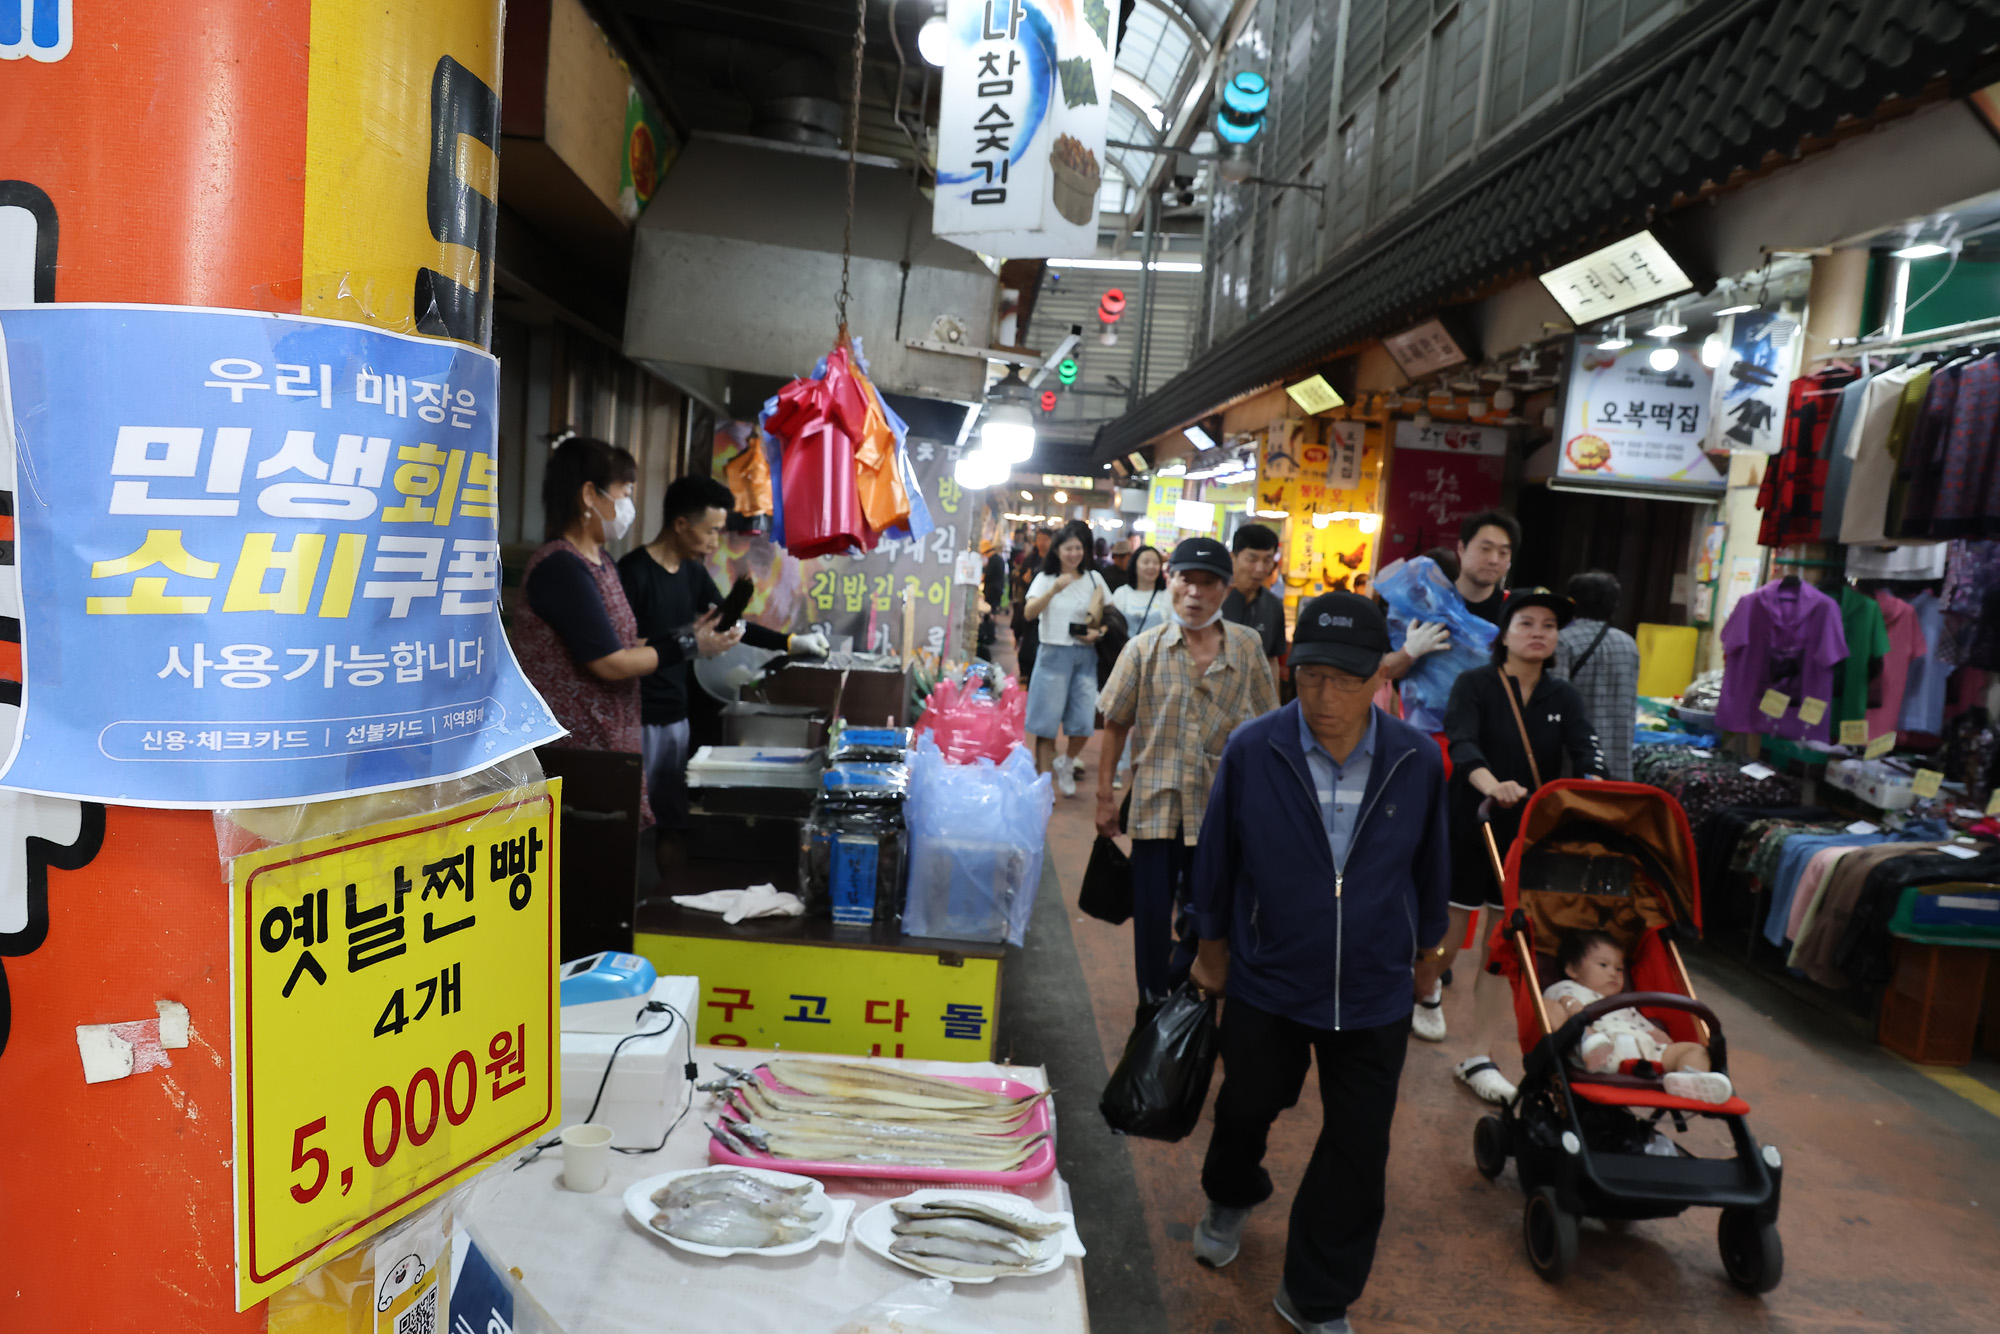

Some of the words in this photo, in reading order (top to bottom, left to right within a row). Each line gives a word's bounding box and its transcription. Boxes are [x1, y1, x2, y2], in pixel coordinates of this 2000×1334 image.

[204, 357, 332, 409] 우리
[356, 373, 477, 429] 매장은
[1597, 401, 1699, 433] 오복떡집
[87, 529, 498, 618] 소비쿠폰
[157, 637, 485, 689] 사용가능합니다
[345, 718, 424, 746] 선불카드
[373, 962, 462, 1038] 4개
[289, 1023, 527, 1204] 5,000원
